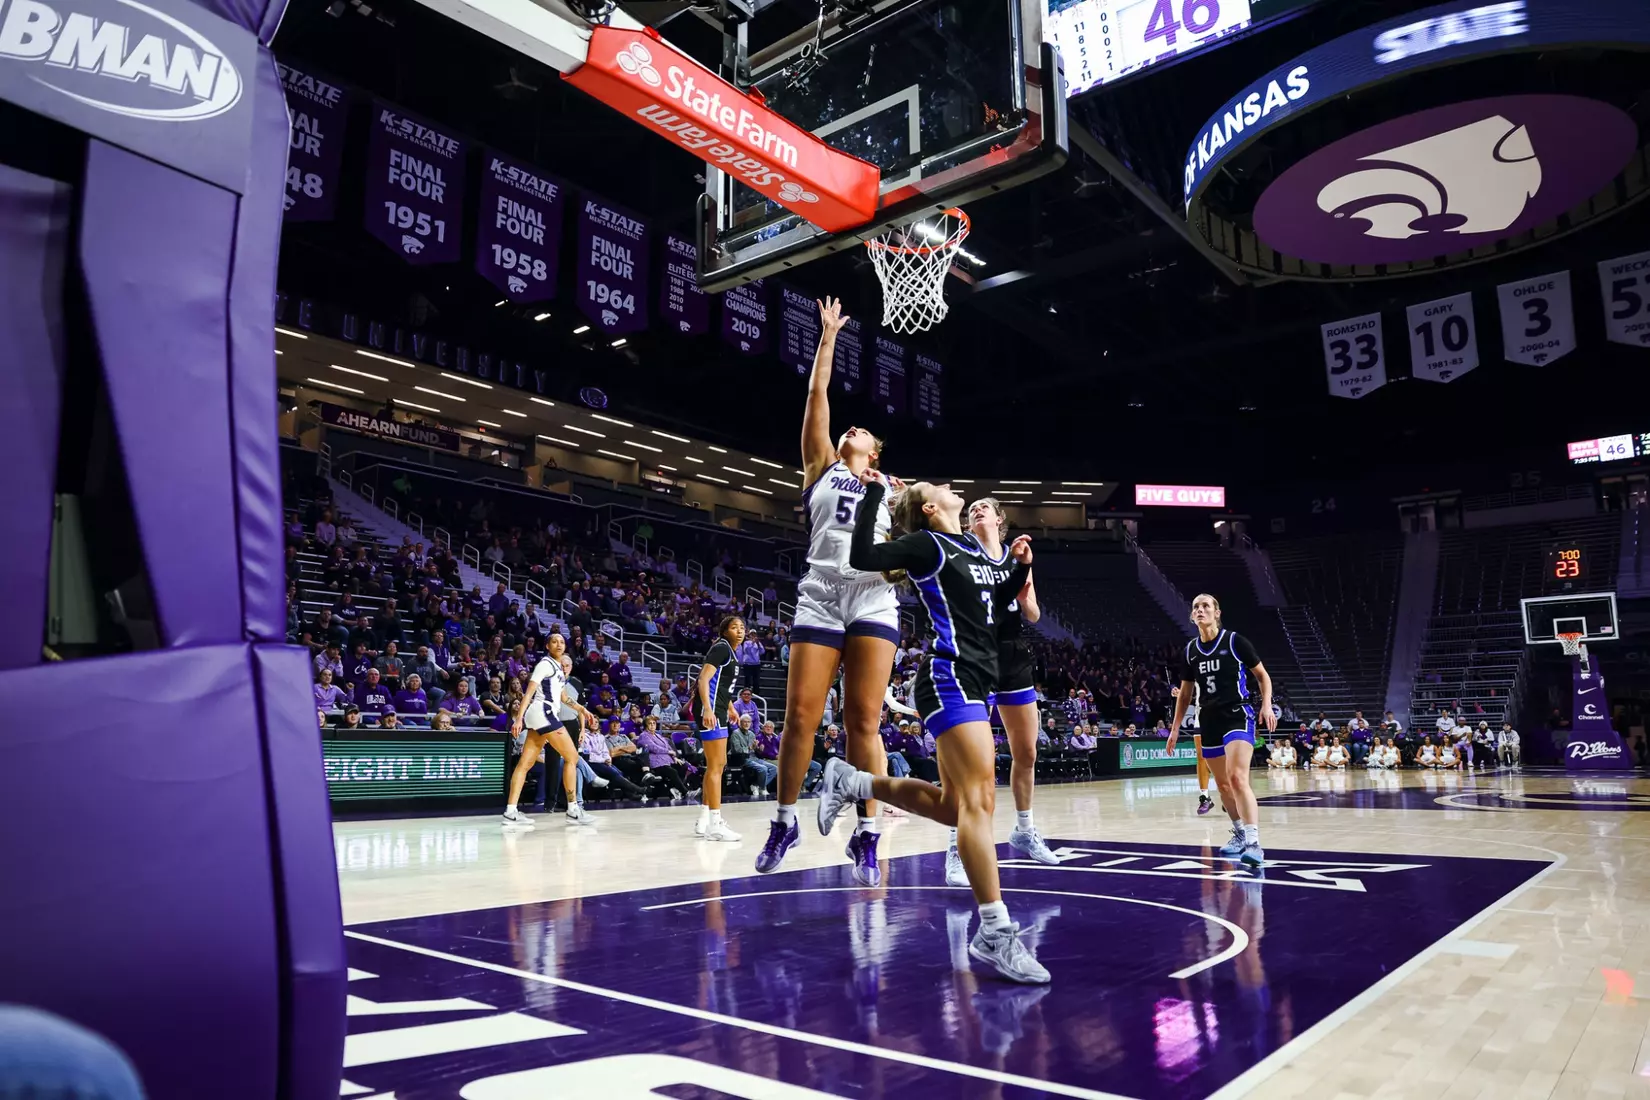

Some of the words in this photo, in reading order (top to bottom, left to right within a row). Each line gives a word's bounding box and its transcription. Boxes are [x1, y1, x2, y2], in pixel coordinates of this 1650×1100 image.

[1100, 12, 1107, 21] 0
[1143, 0, 1220, 46] 46
[1078, 35, 1085, 44] 8
[1102, 25, 1109, 34] 0
[1104, 37, 1110, 46] 0
[1373, 0, 1529, 64] STATE
[1082, 59, 1088, 69] 2
[1106, 49, 1112, 59] 2
[1198, 66, 1310, 171] KANSAS
[380, 109, 460, 154] K-STATE
[410, 135, 453, 159] BASKETBALL
[390, 148, 447, 188] FINAL
[490, 157, 559, 198] K-STATE
[388, 166, 444, 204] FOUR
[384, 201, 445, 243] 1951
[497, 195, 546, 230] FINAL
[585, 200, 644, 236] K-STATE
[496, 212, 544, 245] FOUR
[592, 235, 635, 266] FINAL
[491, 244, 547, 281] 1958
[591, 250, 633, 281] FOUR
[668, 263, 686, 277] ELITE
[670, 276, 684, 287] 1981
[1513, 281, 1556, 297] OHLDE
[587, 280, 636, 315] 1964
[669, 293, 684, 303] 2010
[726, 290, 766, 312] CONFERENCE
[736, 286, 748, 296] BIG
[748, 290, 757, 300] 12
[783, 288, 817, 310] K-STATE
[725, 298, 766, 322] CHAMPIONS
[1424, 303, 1454, 317] GARY
[1523, 298, 1551, 337] 3
[731, 317, 760, 339] 2019
[1327, 321, 1376, 337] ROMSTAD
[1415, 315, 1469, 357] 10
[1330, 334, 1378, 375] 33
[1520, 340, 1560, 353] 2000-04
[1427, 358, 1464, 370] 1981-83
[1606, 443, 1626, 455] 46
[1137, 488, 1173, 502] FIVE
[1177, 489, 1223, 503] GUYS
[836, 495, 855, 524] 5
[1559, 549, 1580, 560] 7:00
[1556, 559, 1580, 578] 23
[1199, 659, 1220, 674] EIU
[1206, 675, 1217, 693] 5
[1135, 749, 1148, 760] OLD
[1567, 741, 1622, 760] Dillons
[423, 757, 482, 780] LINE
